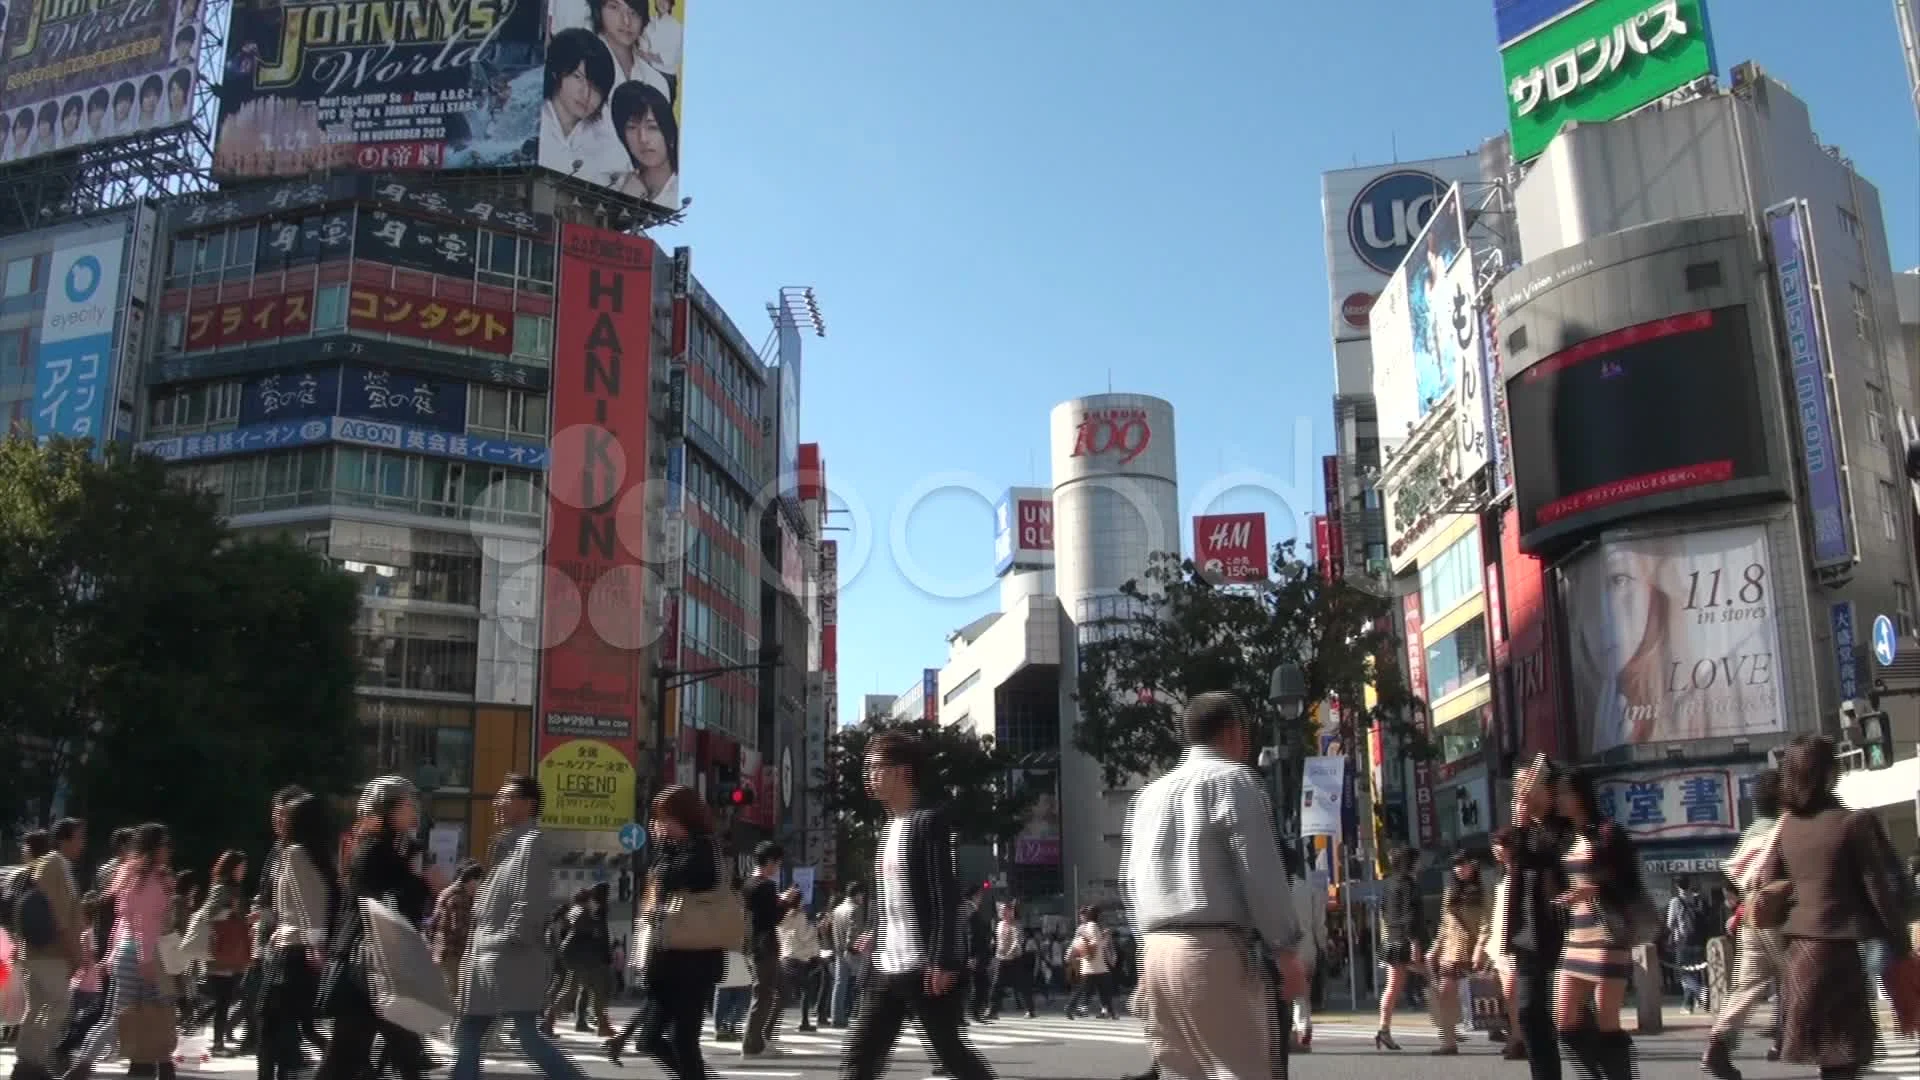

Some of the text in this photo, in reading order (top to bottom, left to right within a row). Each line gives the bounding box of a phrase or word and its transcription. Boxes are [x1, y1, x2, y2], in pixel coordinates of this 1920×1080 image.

[312, 10, 512, 95] World
[1509, 1, 1688, 118] サロンパス
[360, 131, 371, 142] IN
[371, 128, 421, 141] NOVEMBER
[422, 127, 447, 139] 2012
[51, 306, 107, 332] eyecity
[190, 291, 309, 341] プライス
[350, 289, 507, 341] コンタクト
[341, 420, 546, 465] AEON 英会話イーオン
[1069, 417, 1153, 465] 109
[1796, 374, 1828, 474] neon
[1208, 521, 1252, 551] H&M
[1226, 566, 1260, 577] 150m
[1682, 563, 1765, 611] 11.8
[1697, 605, 1768, 625] in stores
[1668, 652, 1773, 694] LOVE
[556, 773, 617, 794] LEGEND
